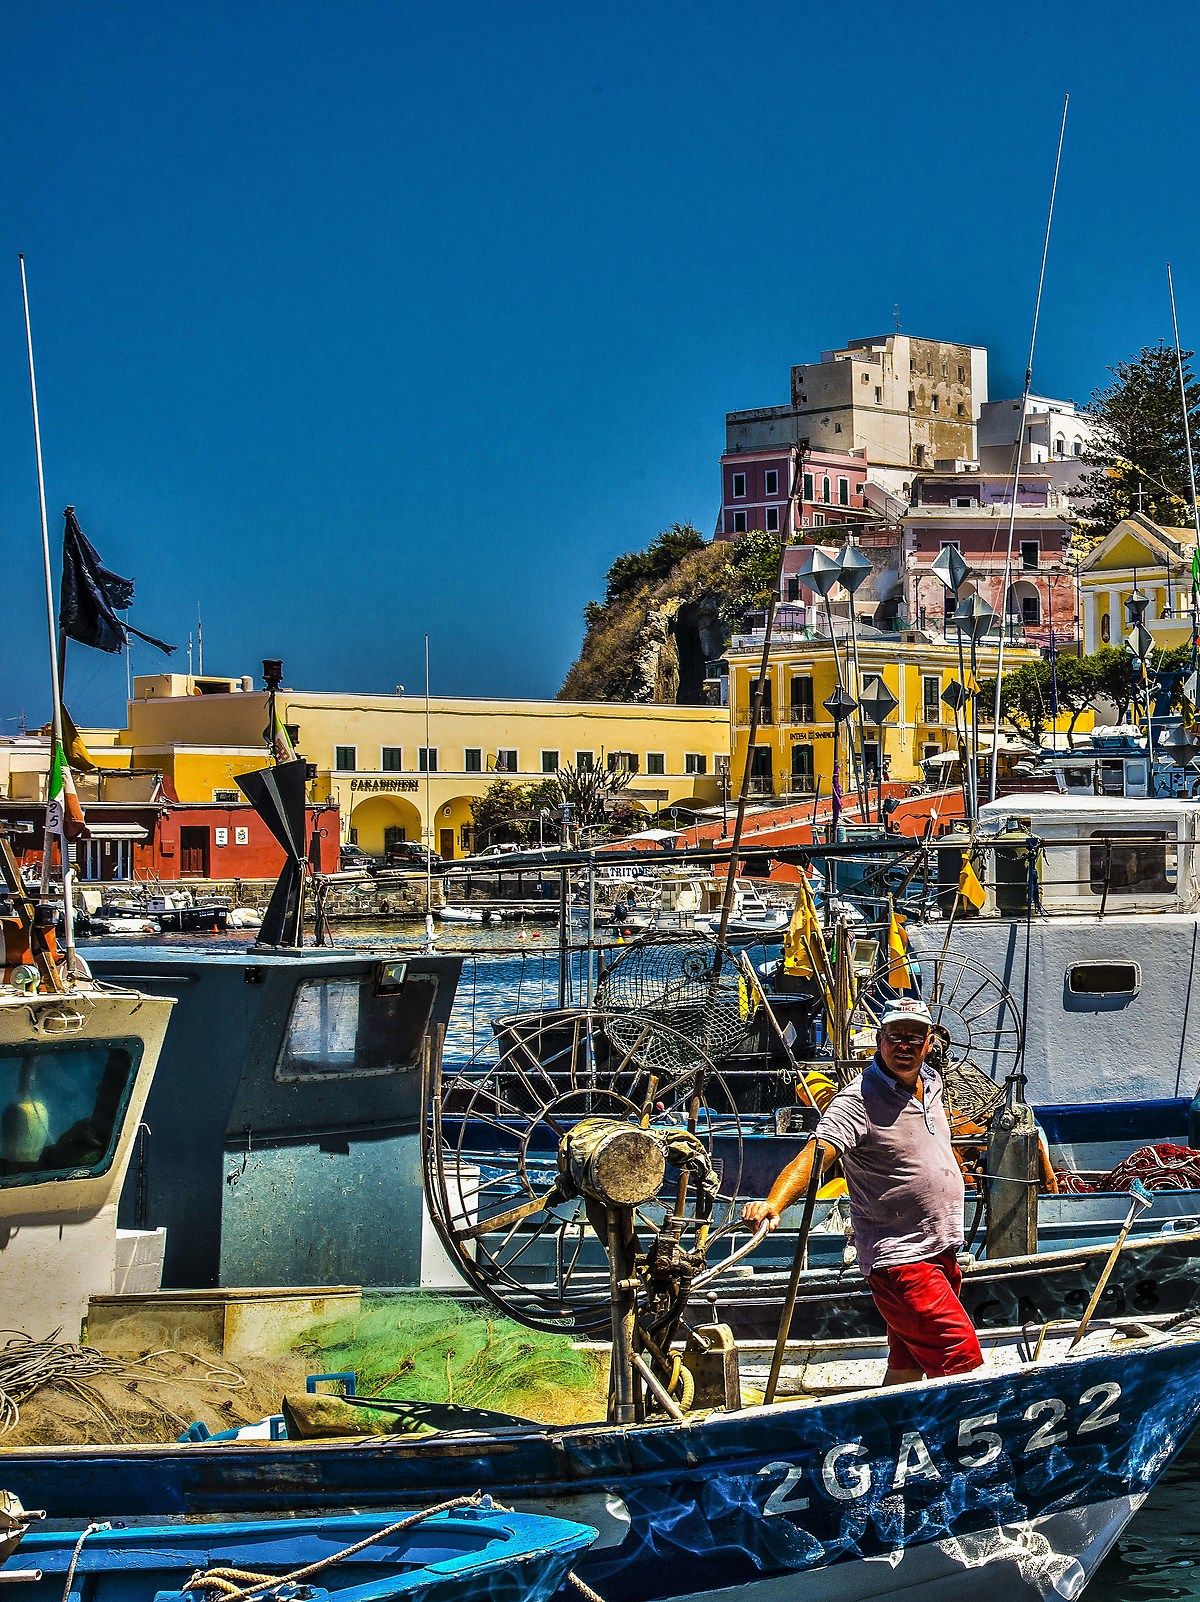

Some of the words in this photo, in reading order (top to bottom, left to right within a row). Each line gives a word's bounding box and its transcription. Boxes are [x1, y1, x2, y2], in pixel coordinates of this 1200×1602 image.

[815, 731, 839, 740] SANPAO
[350, 779, 419, 789] CARABINIERI
[756, 1381, 1123, 1517] 2GA522
